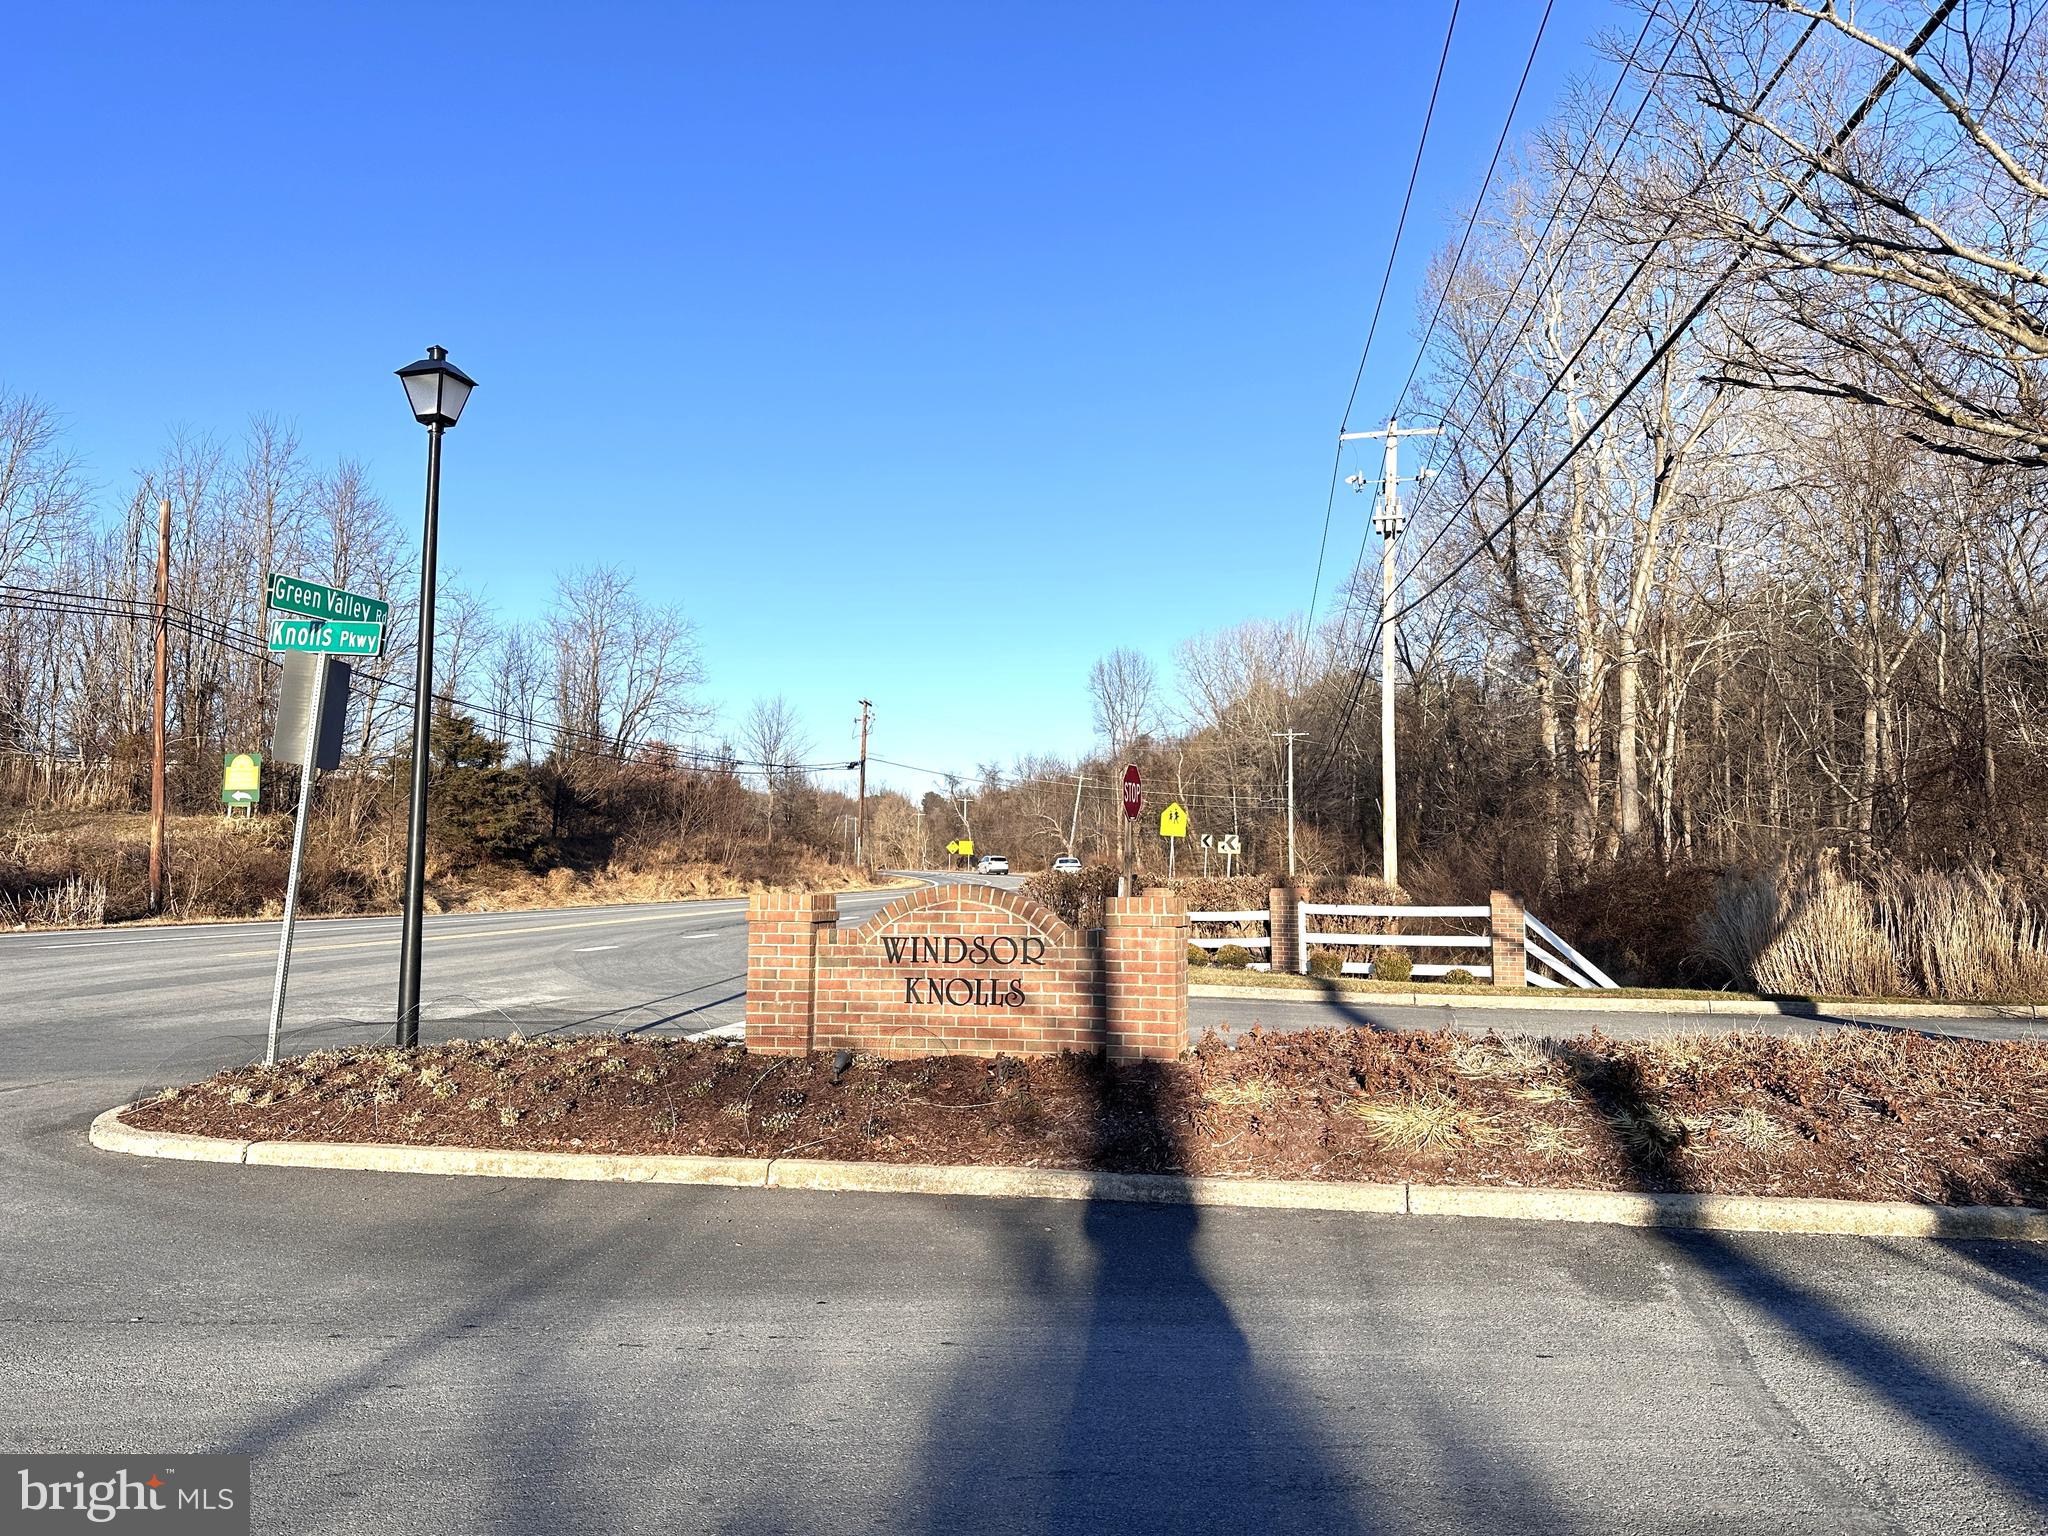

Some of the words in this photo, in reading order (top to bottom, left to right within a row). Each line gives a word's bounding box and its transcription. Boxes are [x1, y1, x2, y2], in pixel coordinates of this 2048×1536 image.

[275, 577, 321, 609] Green
[327, 589, 371, 622] Valley
[375, 609, 387, 623] Rd
[271, 622, 332, 647] Knolls
[339, 630, 376, 652] Pkwy
[1124, 782, 1140, 803] STOP
[881, 935, 1046, 966] WINDSOR
[904, 977, 1026, 1008] KNOLLS
